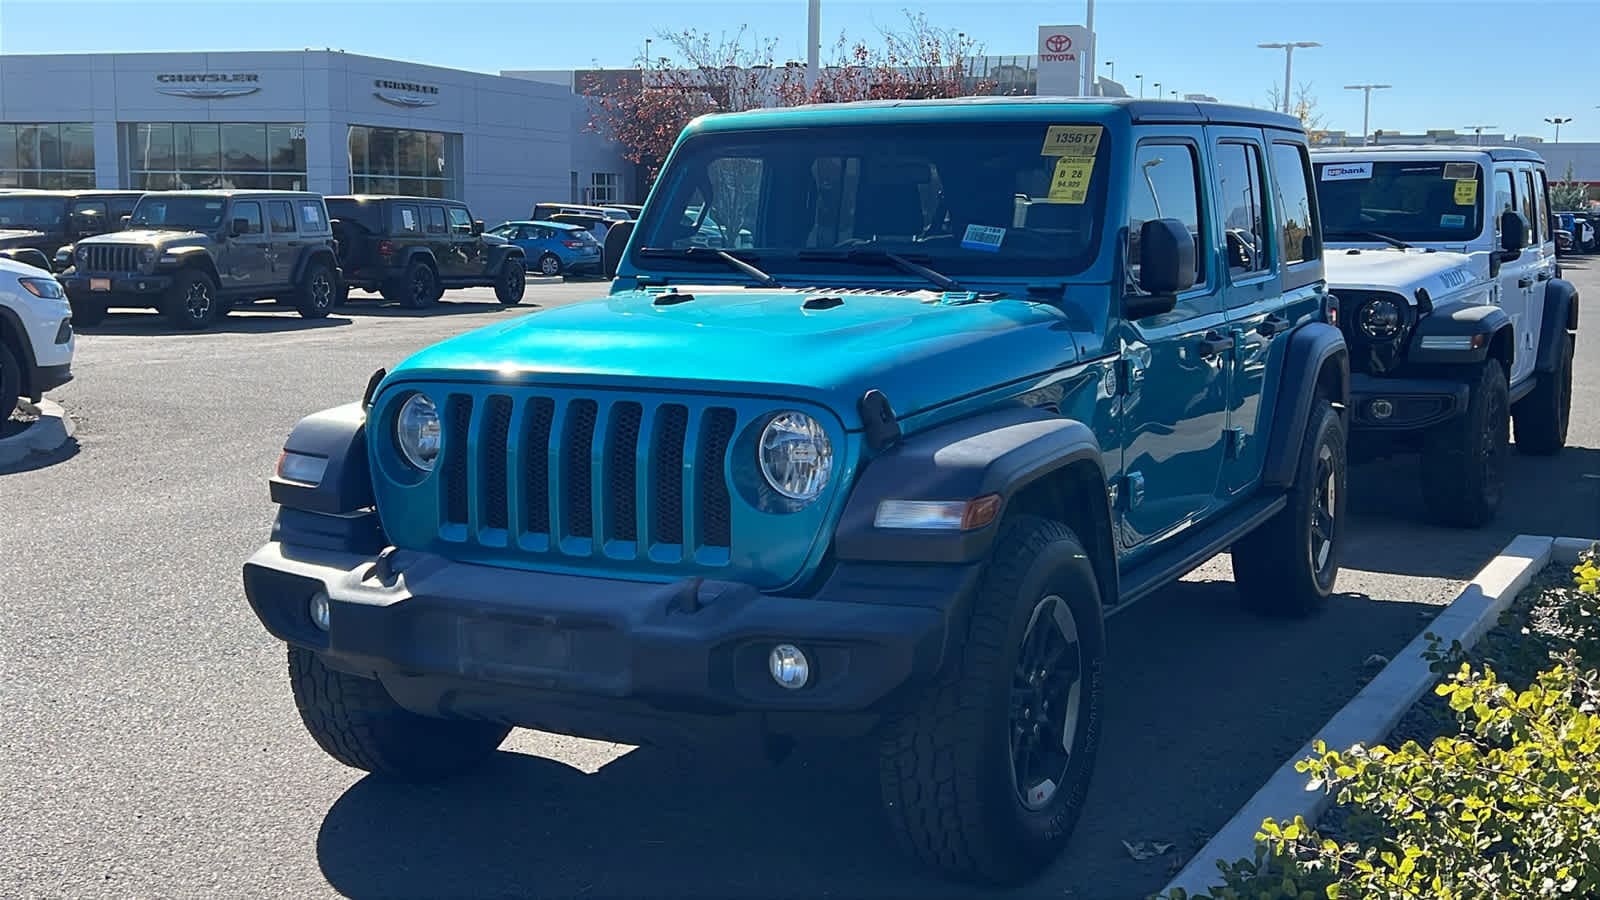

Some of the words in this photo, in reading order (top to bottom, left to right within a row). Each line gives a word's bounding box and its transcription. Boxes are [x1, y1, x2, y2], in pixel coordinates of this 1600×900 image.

[156, 73, 259, 83] CHRYSLER
[374, 79, 440, 95] CHRYSLER
[1055, 132, 1097, 144] 135617
